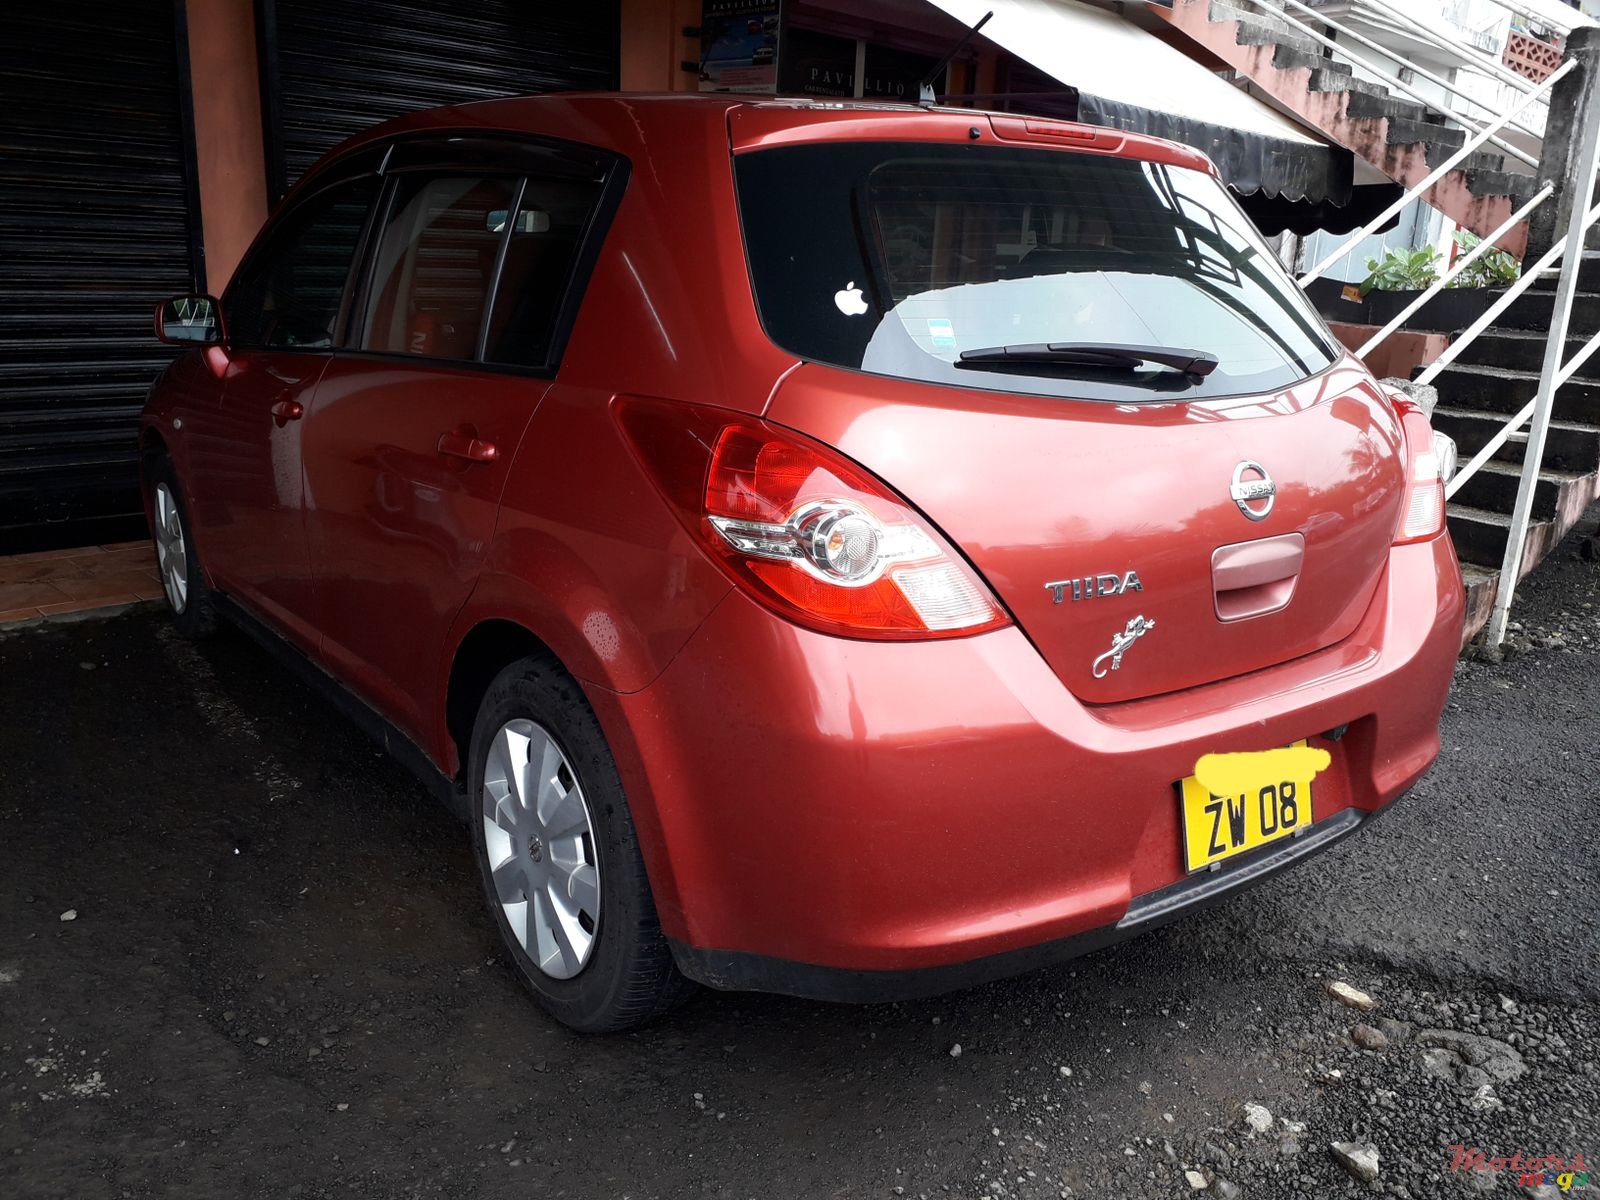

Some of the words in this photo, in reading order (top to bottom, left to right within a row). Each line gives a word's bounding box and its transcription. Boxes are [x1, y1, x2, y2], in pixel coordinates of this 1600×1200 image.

[1239, 482, 1274, 497] NISSAN
[1044, 571, 1144, 604] TIIDA
[1204, 794, 1246, 857] ZW
[1259, 782, 1298, 837] 08
